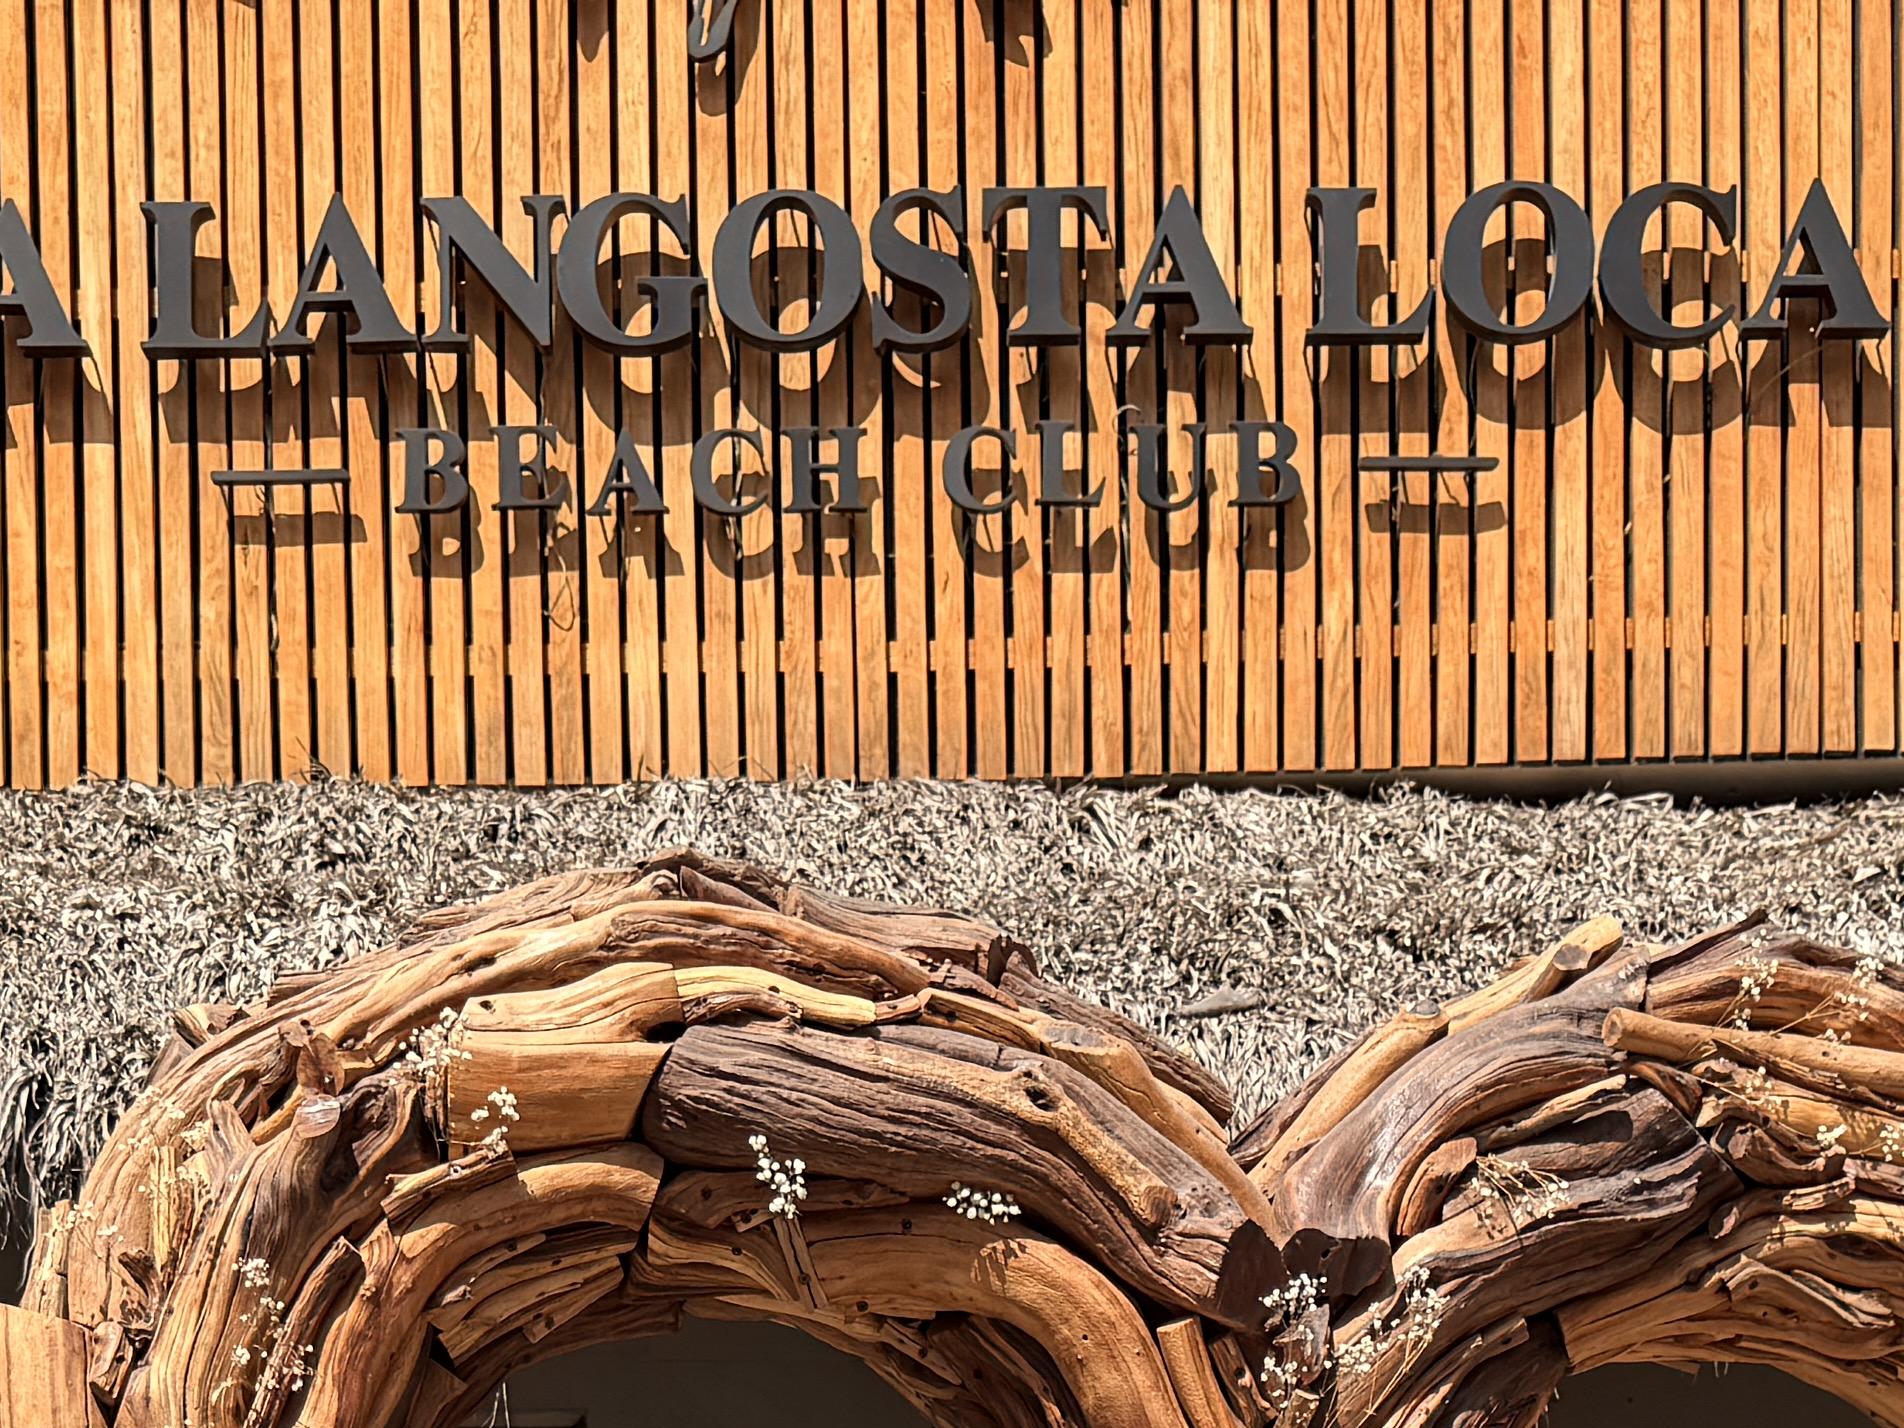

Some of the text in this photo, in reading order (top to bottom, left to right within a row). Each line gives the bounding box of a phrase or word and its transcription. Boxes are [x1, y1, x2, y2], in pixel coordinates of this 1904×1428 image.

[139, 181, 1255, 358] LANGOSTA
[1304, 177, 1893, 350] LOCA
[394, 418, 1300, 517] BEACH CLUB
